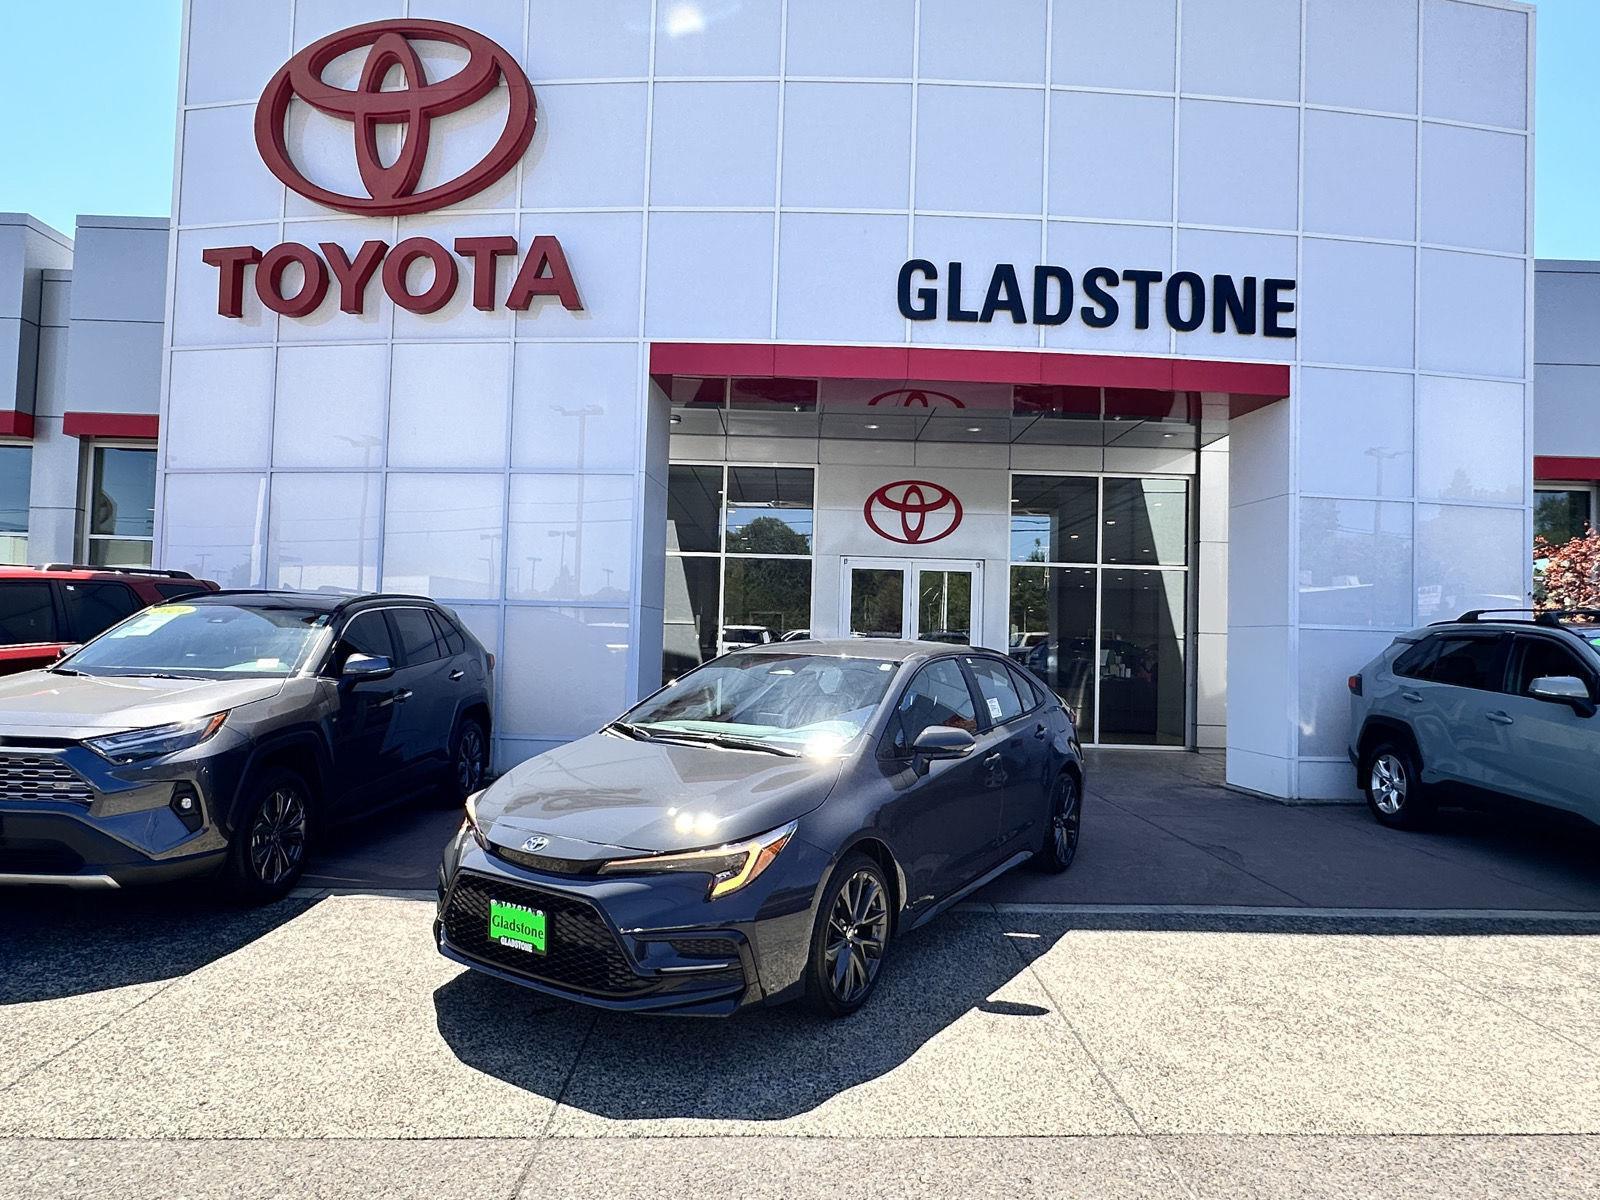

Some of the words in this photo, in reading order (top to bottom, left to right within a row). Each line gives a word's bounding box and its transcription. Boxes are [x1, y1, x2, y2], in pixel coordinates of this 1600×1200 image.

[202, 235, 584, 318] TOYOTA
[897, 258, 1297, 338] GLADSTONE
[492, 915, 544, 940] Gladstone
